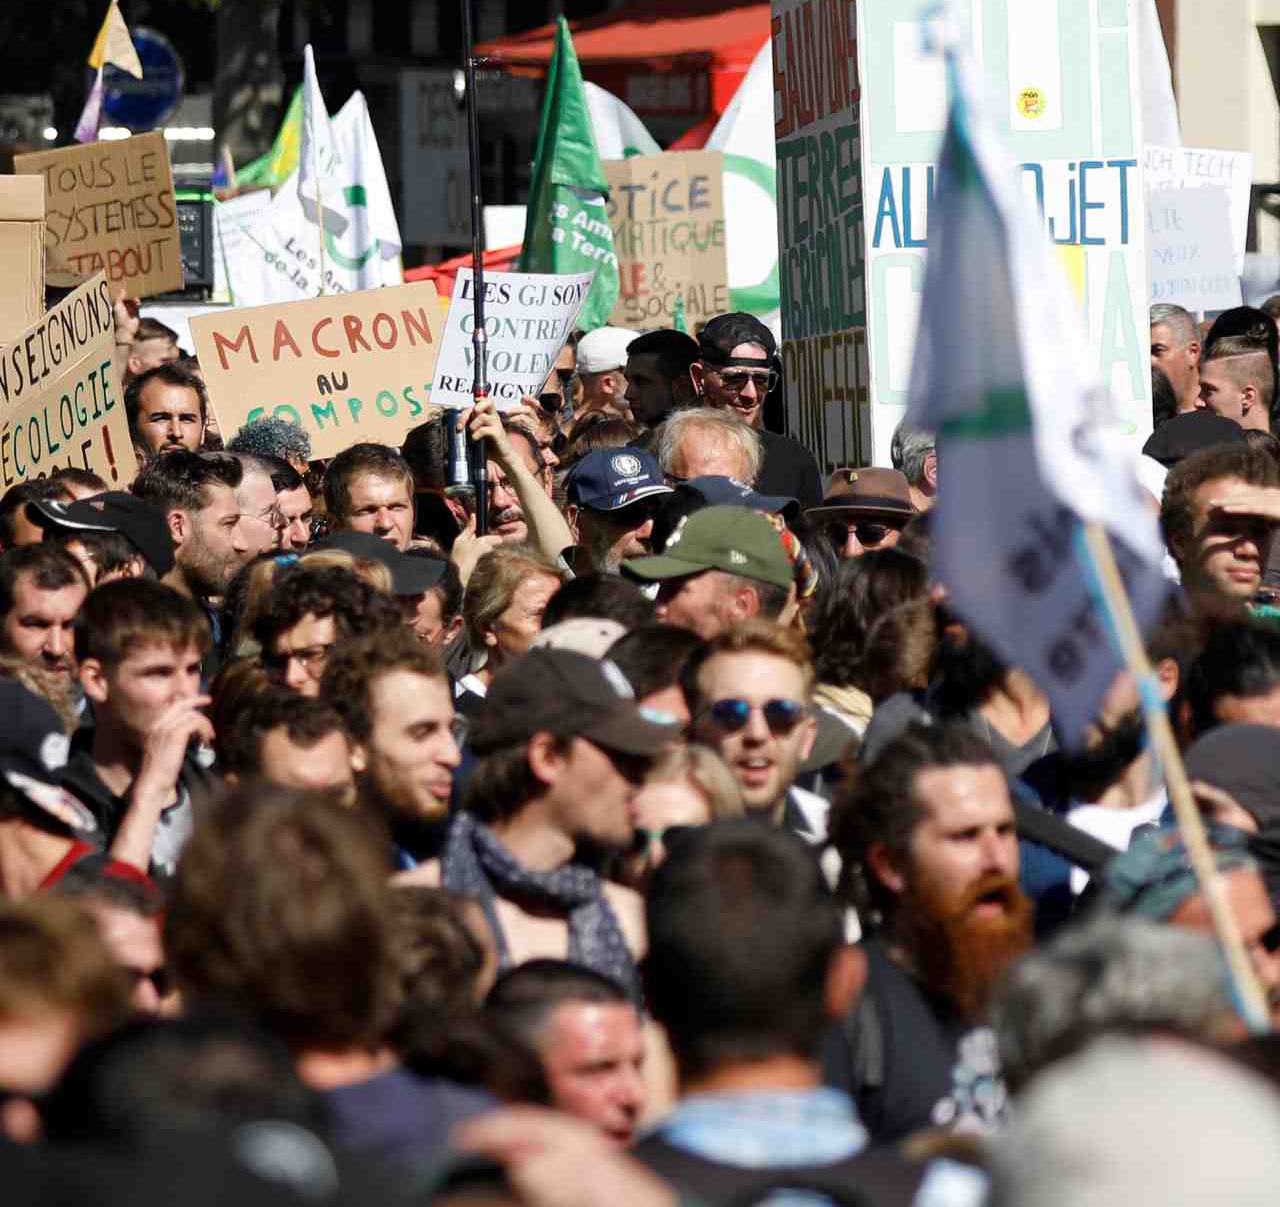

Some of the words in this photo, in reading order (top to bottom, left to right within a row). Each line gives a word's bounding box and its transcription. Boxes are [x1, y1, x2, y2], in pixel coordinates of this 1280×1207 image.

[39, 156, 117, 196] TOUS
[123, 151, 157, 186] LE
[285, 236, 319, 270] Les
[518, 284, 548, 307] GJ
[623, 281, 729, 324] SOCALE
[211, 307, 433, 370] MACRON
[316, 371, 350, 396] AU
[246, 383, 433, 430] COMPOS
